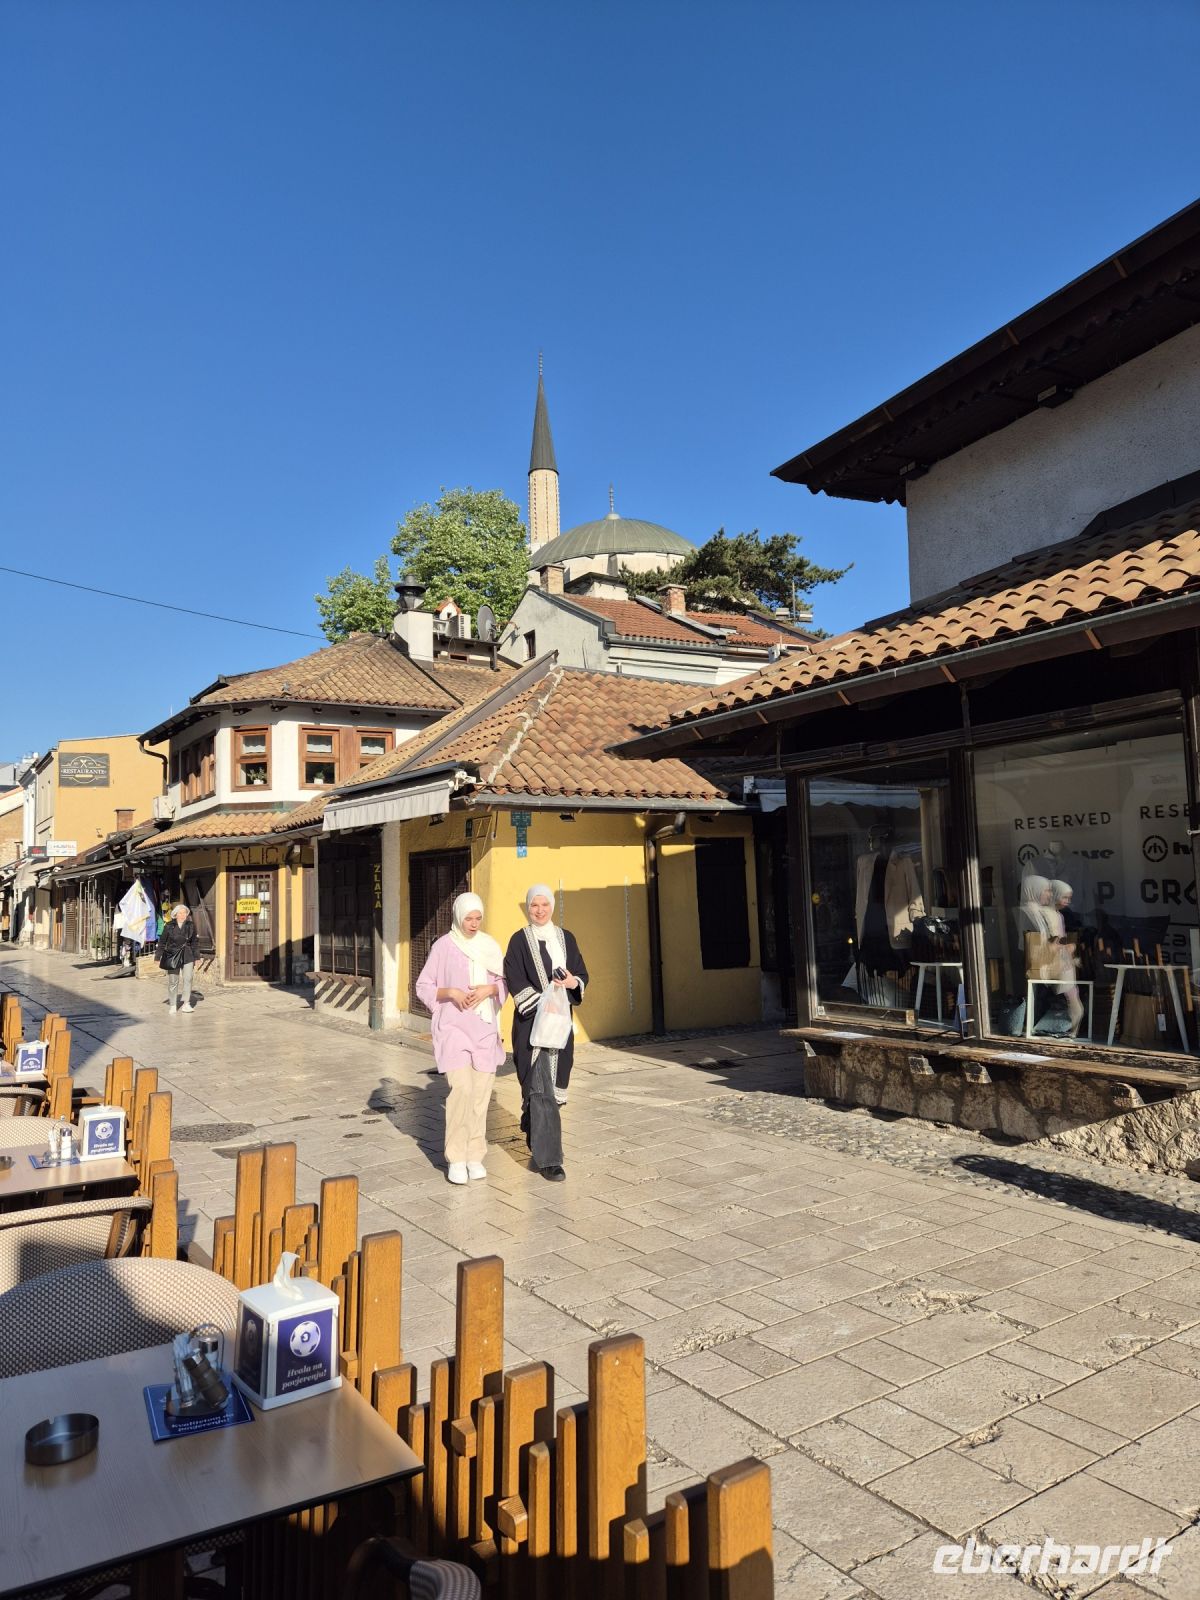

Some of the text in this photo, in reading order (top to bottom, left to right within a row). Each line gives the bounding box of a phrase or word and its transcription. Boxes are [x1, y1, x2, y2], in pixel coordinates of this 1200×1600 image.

[1014, 812, 1111, 830] RESERVED
[374, 864, 382, 909] ZLATA
[282, 1369, 327, 1391] povjerenju!
[287, 1362, 323, 1378] Hvala na
